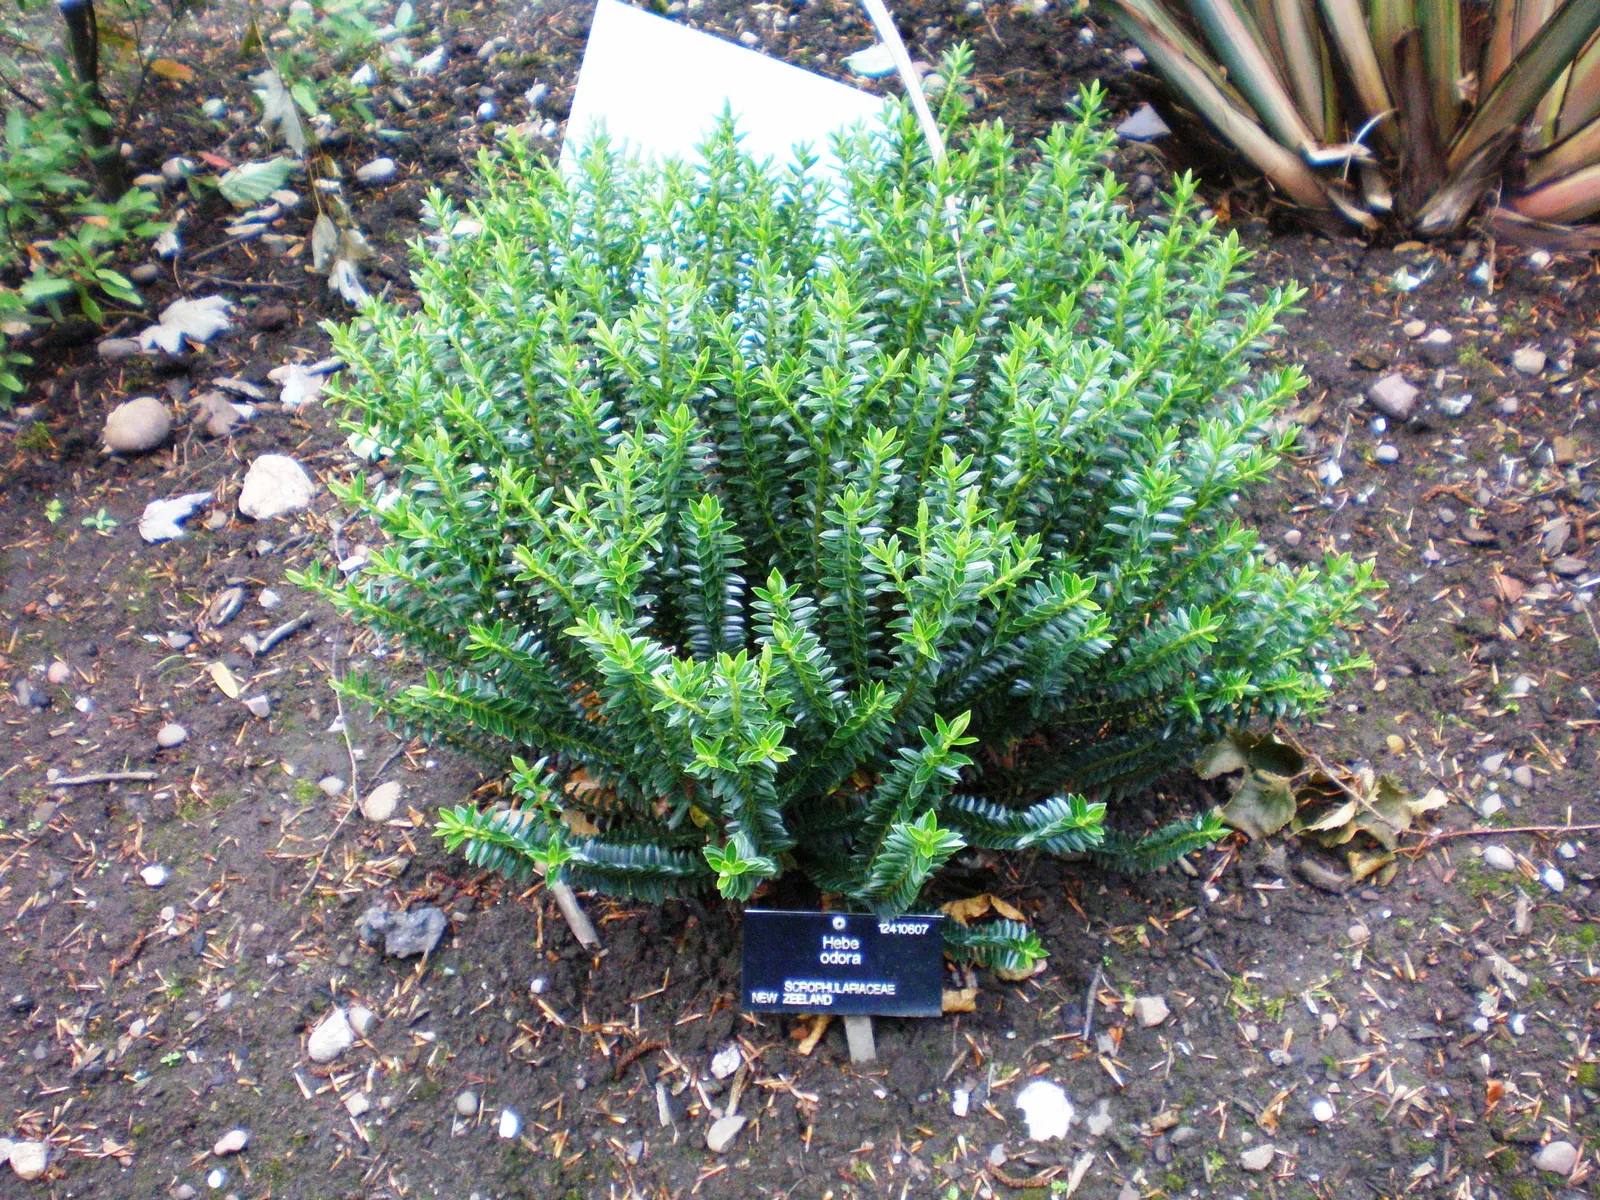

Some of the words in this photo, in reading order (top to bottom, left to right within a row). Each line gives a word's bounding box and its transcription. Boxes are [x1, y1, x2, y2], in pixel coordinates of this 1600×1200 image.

[822, 936, 860, 950] Hebe
[819, 951, 862, 965] odora
[751, 992, 778, 1005] NEW
